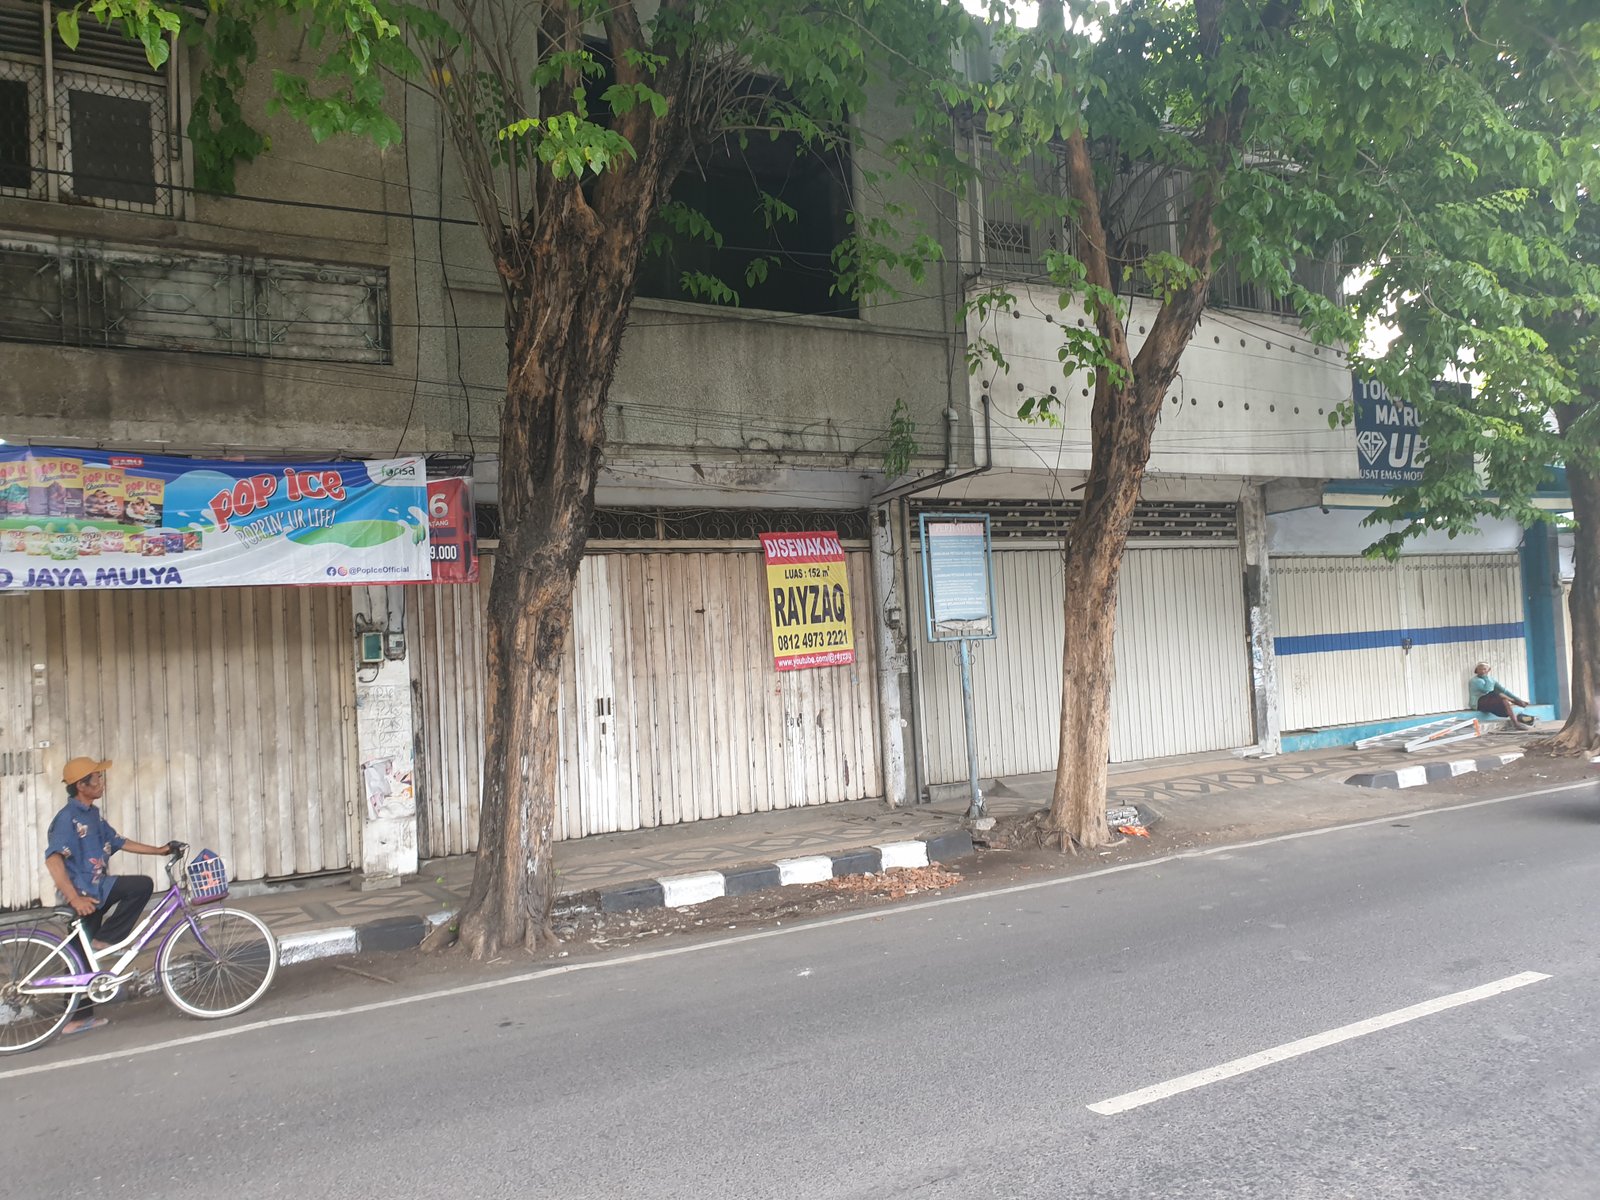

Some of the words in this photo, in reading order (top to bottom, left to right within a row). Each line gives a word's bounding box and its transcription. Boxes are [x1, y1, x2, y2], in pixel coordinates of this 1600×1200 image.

[1360, 379, 1401, 402] TOK
[1376, 404, 1425, 427] MA'RU
[1388, 432, 1430, 469] UB
[1360, 469, 1379, 479] USAT
[1381, 470, 1401, 480] EMAS
[1403, 471, 1424, 481] MOD
[235, 511, 284, 549] POPPIN'
[288, 508, 308, 530] UR
[307, 507, 336, 529] LIFE!
[430, 545, 457, 560] 9.000
[764, 537, 842, 559] DISEWAKAN
[22, 567, 88, 588] JAYA
[95, 566, 183, 587] MULYA
[349, 566, 410, 576] @PopIceOfficial
[784, 568, 803, 580] LUAS
[808, 567, 821, 578] 152
[773, 583, 846, 628] RAYZAQ
[777, 633, 800, 651] 0812
[802, 631, 825, 649] 4973
[826, 629, 849, 647] 2221
